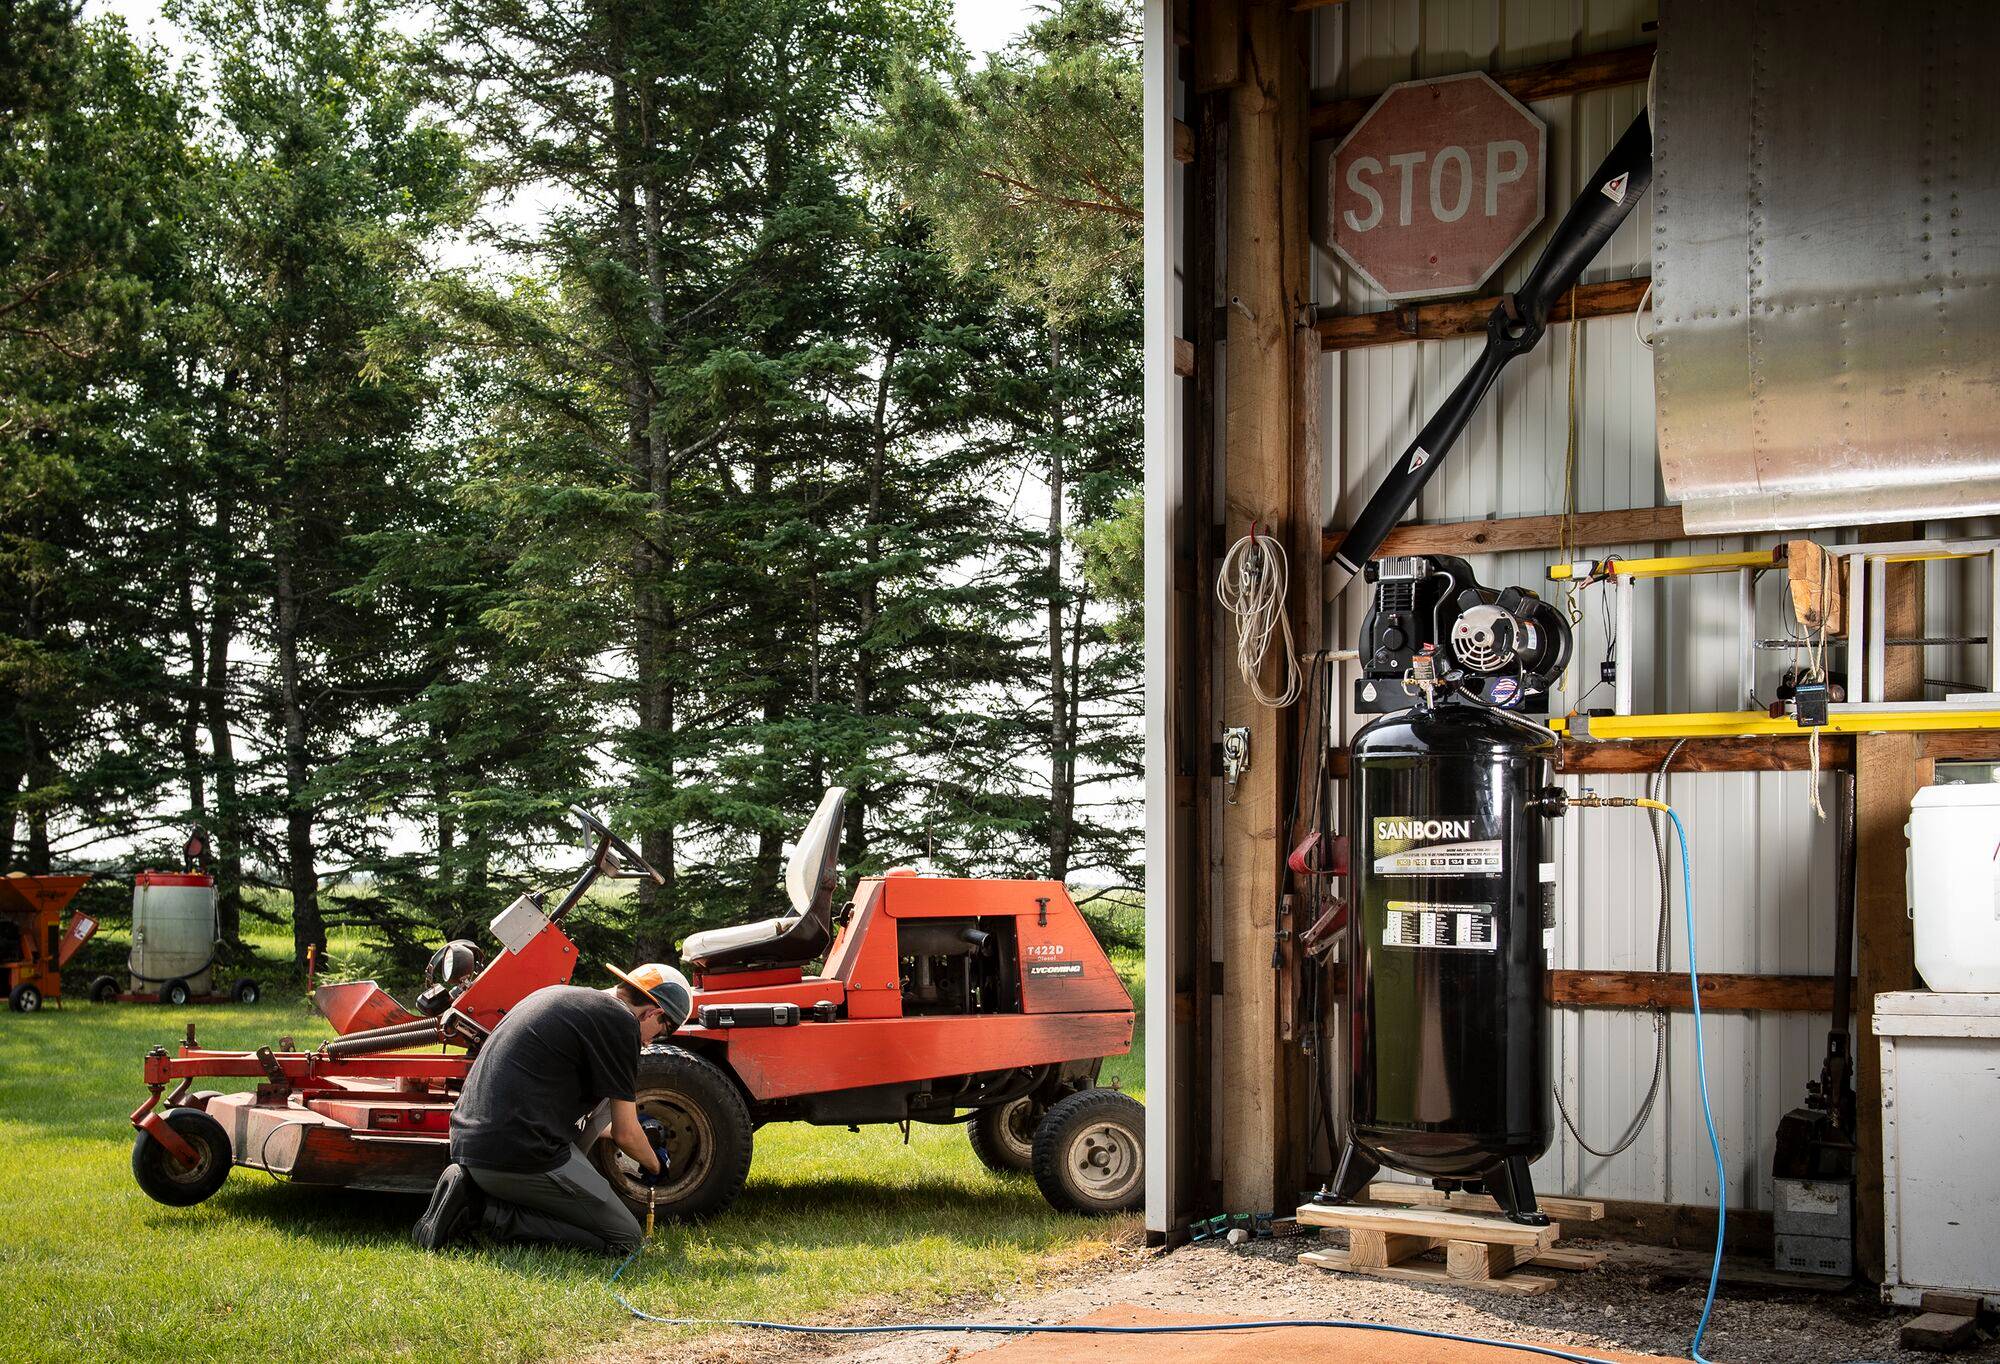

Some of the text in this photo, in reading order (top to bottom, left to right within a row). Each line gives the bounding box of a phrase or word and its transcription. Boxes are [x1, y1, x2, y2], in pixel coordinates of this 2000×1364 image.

[1343, 139, 1529, 233] STOP
[1378, 820, 1470, 840] SANBORN
[1027, 945, 1064, 955] T422D
[1030, 965, 1081, 974] LYCOMING
